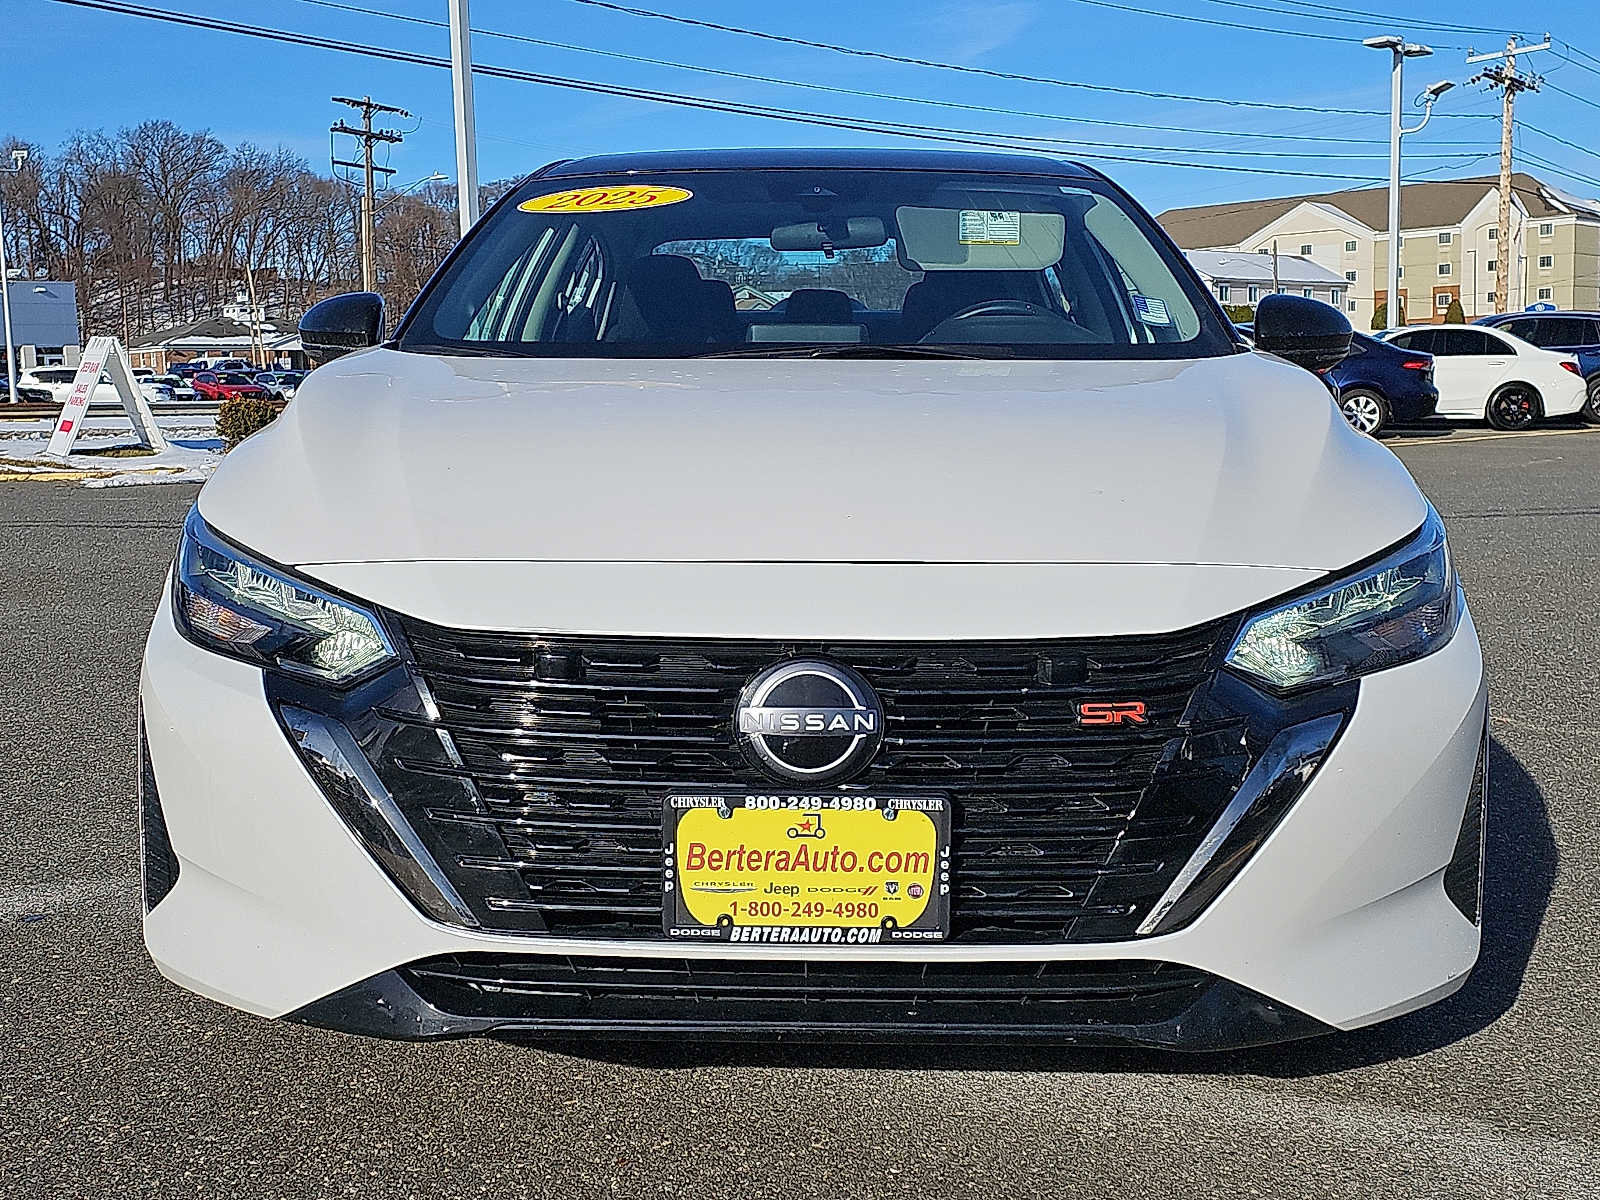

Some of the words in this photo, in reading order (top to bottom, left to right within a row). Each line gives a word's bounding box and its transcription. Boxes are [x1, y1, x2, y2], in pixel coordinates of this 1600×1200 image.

[544, 190, 667, 209] 2025
[1081, 702, 1145, 723] SR
[742, 713, 874, 732] NISSAN
[670, 796, 726, 809] CHRYSLER
[744, 796, 877, 811] 800-249-4980
[888, 799, 944, 812] CHRYSLER
[664, 843, 674, 893] Jeep
[686, 843, 930, 874] BerteraAuto.com
[940, 846, 950, 895] Jeep
[764, 882, 800, 896] Jeep
[729, 901, 879, 918] 1-800-249-4980
[670, 928, 721, 936] DODGE
[730, 926, 882, 943] BERTERAAUTO.COM
[891, 931, 943, 939] DODGE
